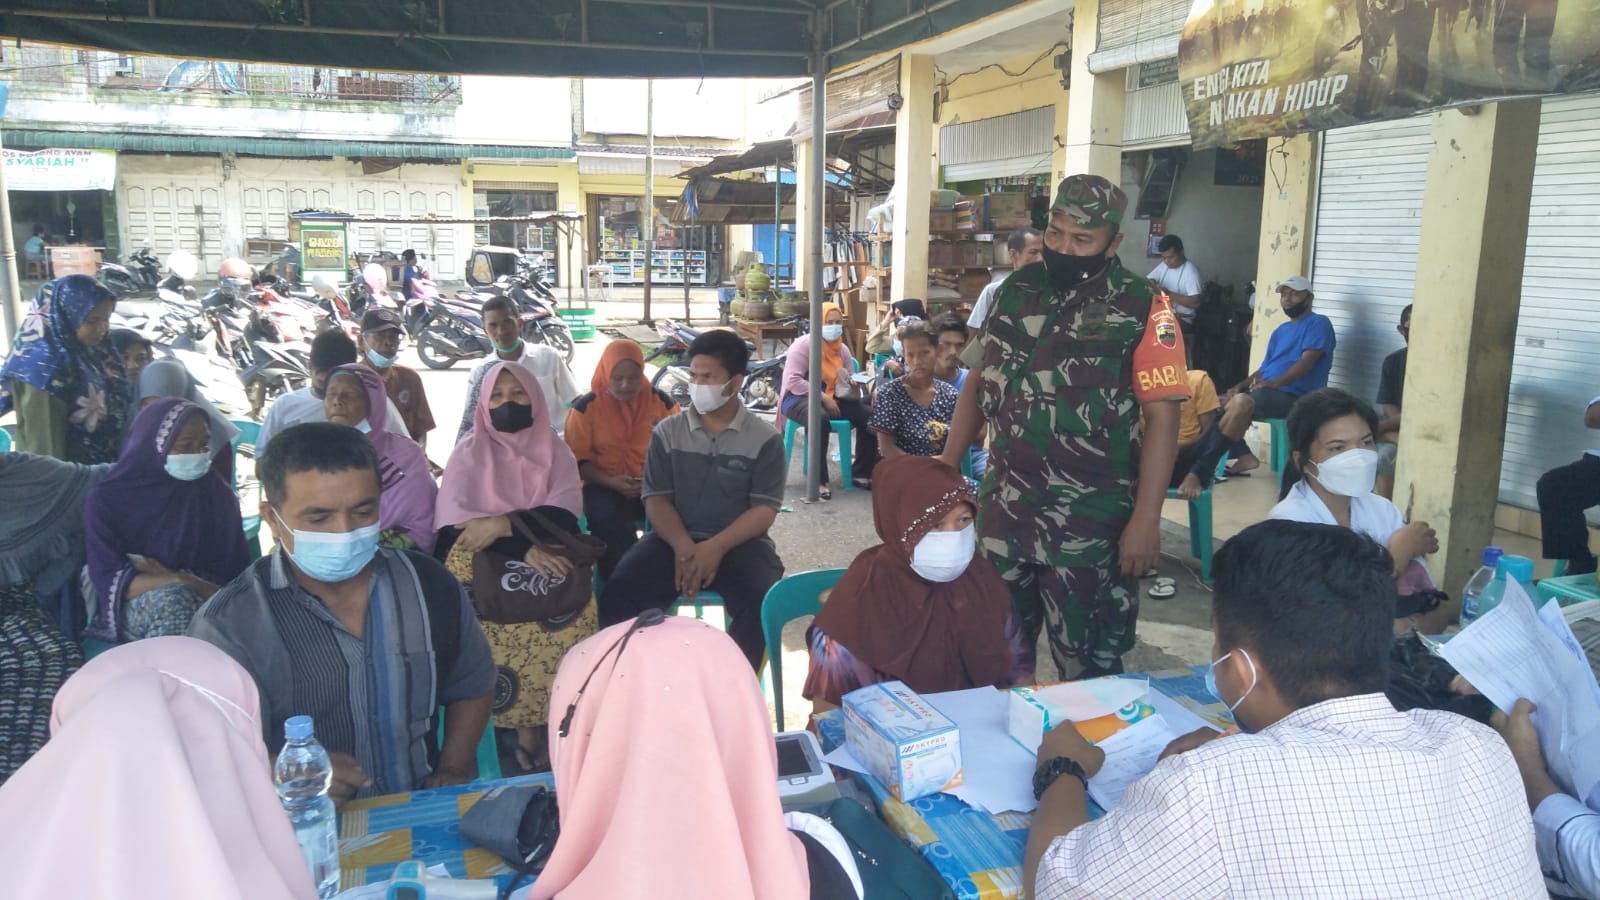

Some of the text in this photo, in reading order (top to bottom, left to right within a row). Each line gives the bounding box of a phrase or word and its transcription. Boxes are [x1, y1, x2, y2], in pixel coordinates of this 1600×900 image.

[1231, 59, 1270, 88] KITA
[1283, 74, 1348, 112] HIDUP
[6, 157, 75, 167] SYARIAH
